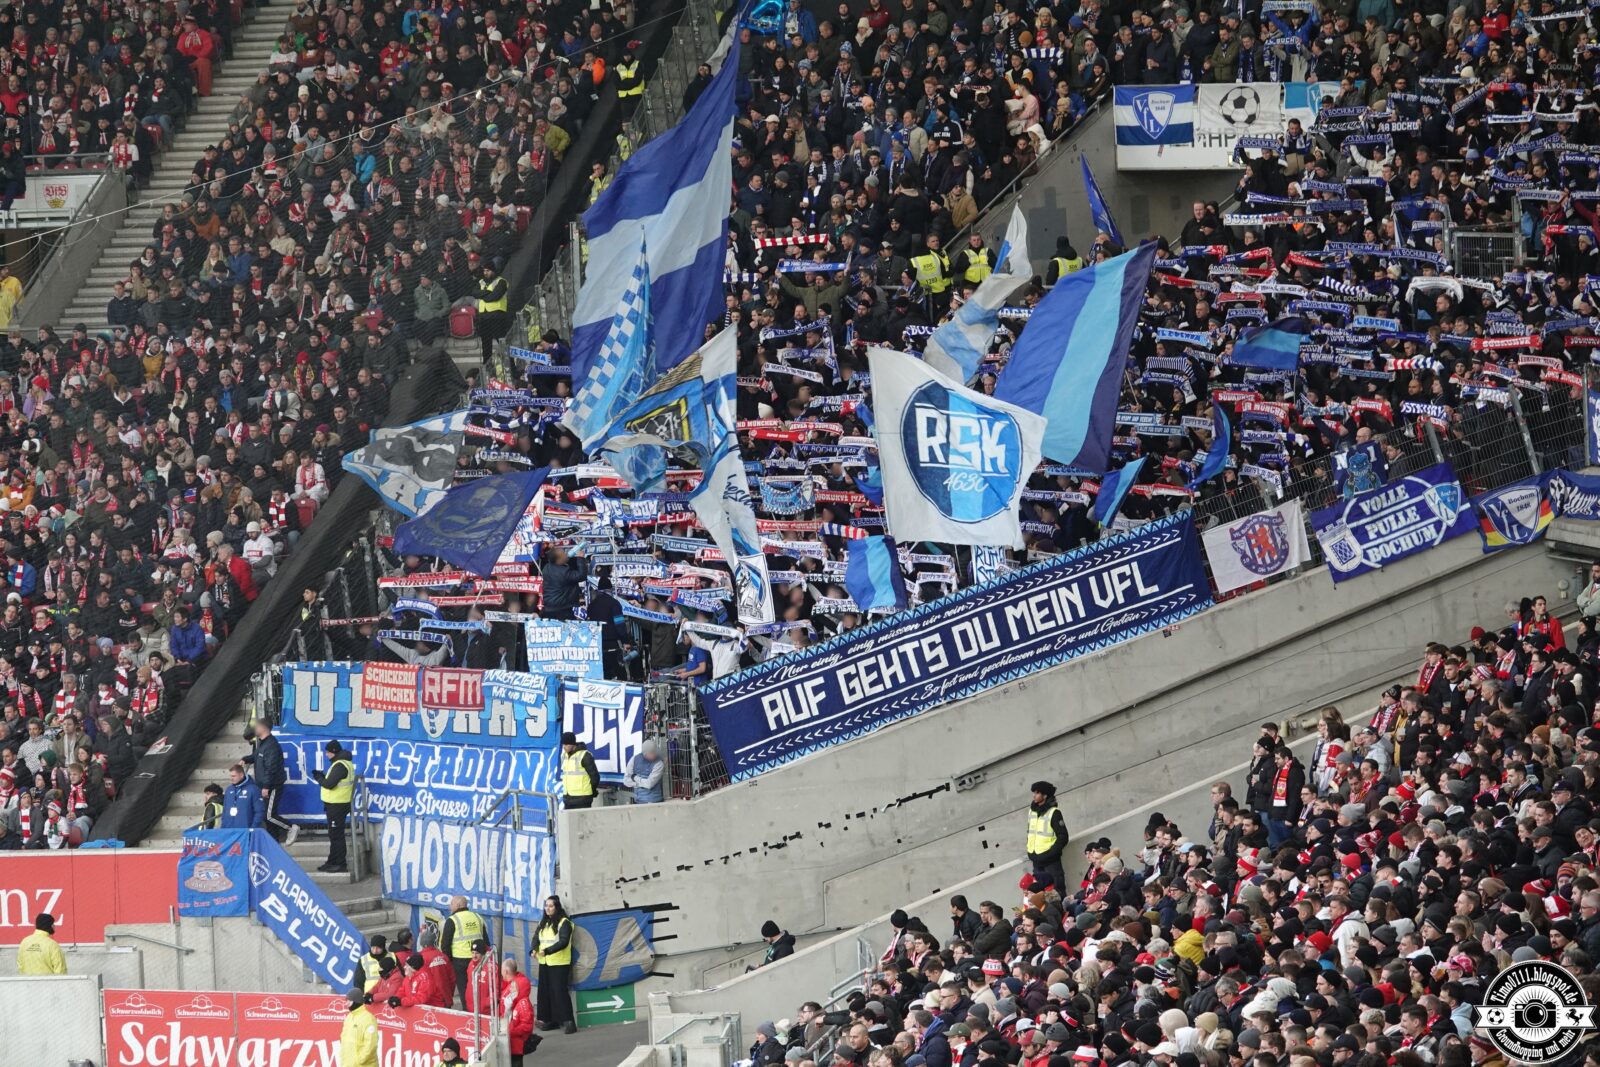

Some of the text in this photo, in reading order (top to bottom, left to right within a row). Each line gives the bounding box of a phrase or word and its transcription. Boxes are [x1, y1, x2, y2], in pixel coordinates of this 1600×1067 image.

[44, 184, 68, 197] VfB
[914, 407, 1010, 473] RSK
[1359, 484, 1410, 516] VOLLE
[1508, 491, 1536, 505] Bochum
[1516, 501, 1532, 513] 1848
[1365, 505, 1421, 540] PULLE
[1366, 523, 1439, 563] BOCHUM
[490, 563, 528, 575] ÜNCHEN
[529, 626, 563, 644] GEGEN
[760, 561, 1160, 731] AUF GEHTS DU MEIN VFL
[773, 662, 809, 681] Nur
[847, 637, 875, 655] einig
[877, 620, 921, 643] müssen
[922, 613, 942, 628] wir
[527, 646, 600, 663] STADIONVERBOTE
[938, 676, 958, 698] fest
[957, 667, 980, 686] und
[979, 648, 1036, 680] geschlossen
[1035, 642, 1052, 657] wie
[1053, 633, 1077, 652] Erz
[1077, 627, 1101, 645] und
[1100, 610, 1142, 634] Gestein
[365, 666, 417, 686] SCHICKERIA
[424, 671, 483, 705] RFM
[364, 683, 417, 704] MÜNCHEN
[585, 684, 609, 701] Block
[415, 788, 470, 818] Strasse
[382, 817, 552, 911] PHOTOMAFIA
[418, 891, 524, 915] BOHUM
[272, 869, 362, 964] ALARMSTUFE
[259, 892, 354, 986] BLAU
[110, 1007, 162, 1016] Schwarzwaldmilch
[176, 1008, 229, 1018] Schwarzwaldmilch
[245, 1011, 298, 1020] Schwarzwaldmilch
